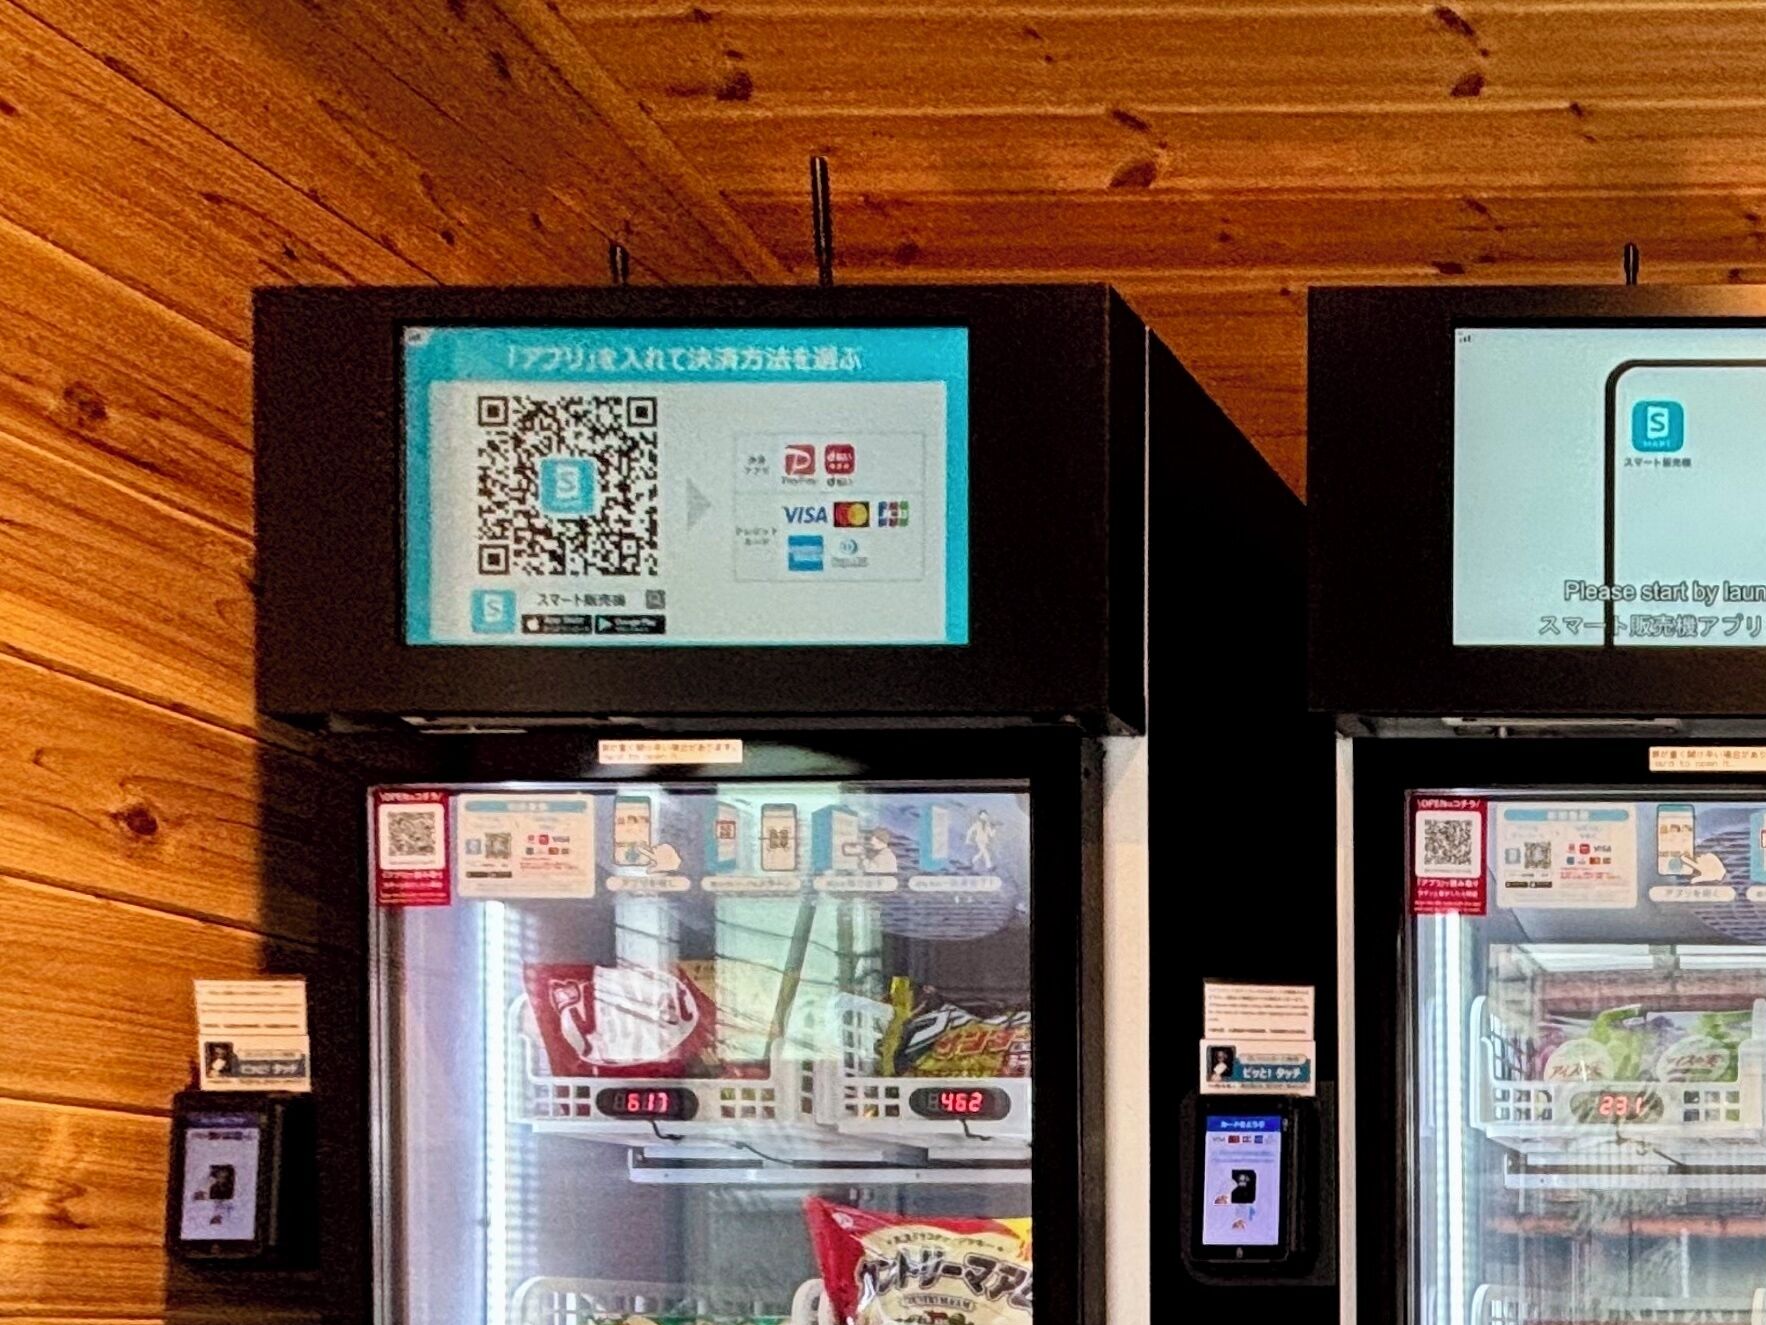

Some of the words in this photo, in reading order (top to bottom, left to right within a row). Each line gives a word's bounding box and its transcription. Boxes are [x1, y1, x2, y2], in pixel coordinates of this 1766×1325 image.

[1650, 412, 1665, 432] S
[784, 506, 828, 524] VISA
[1564, 580, 1636, 602] Please
[1640, 581, 1687, 602] start
[1692, 581, 1718, 607] by
[627, 1093, 668, 1112] 617
[941, 1092, 983, 1111] 462
[1599, 1097, 1641, 1114] 231
